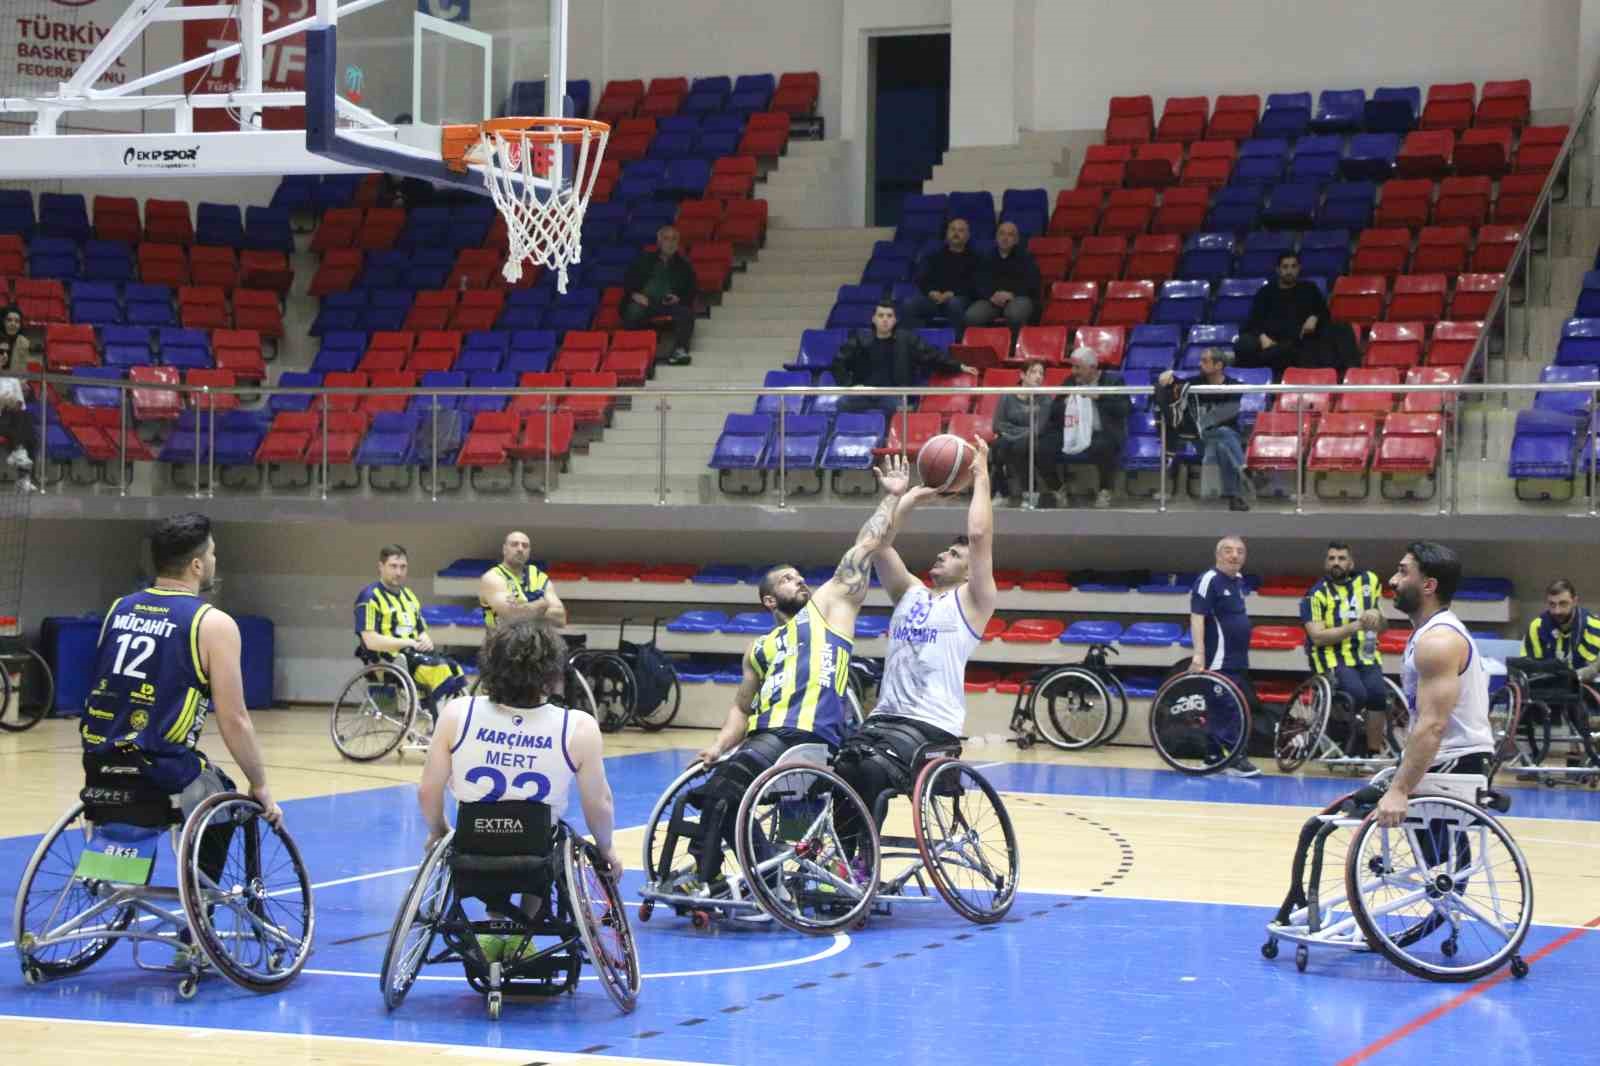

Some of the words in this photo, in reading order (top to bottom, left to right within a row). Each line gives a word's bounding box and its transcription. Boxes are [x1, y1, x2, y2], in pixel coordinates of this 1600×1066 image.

[16, 15, 112, 44] TÜRKİY
[17, 43, 126, 67] BASKETL
[16, 63, 126, 84] FEDERANU
[112, 613, 178, 638] MÜCAHİT
[112, 633, 156, 680] 12
[476, 727, 553, 749] KARÇİMSA
[485, 750, 537, 769] MERT
[474, 818, 524, 829] EXTRA
[104, 845, 139, 858] aksa
